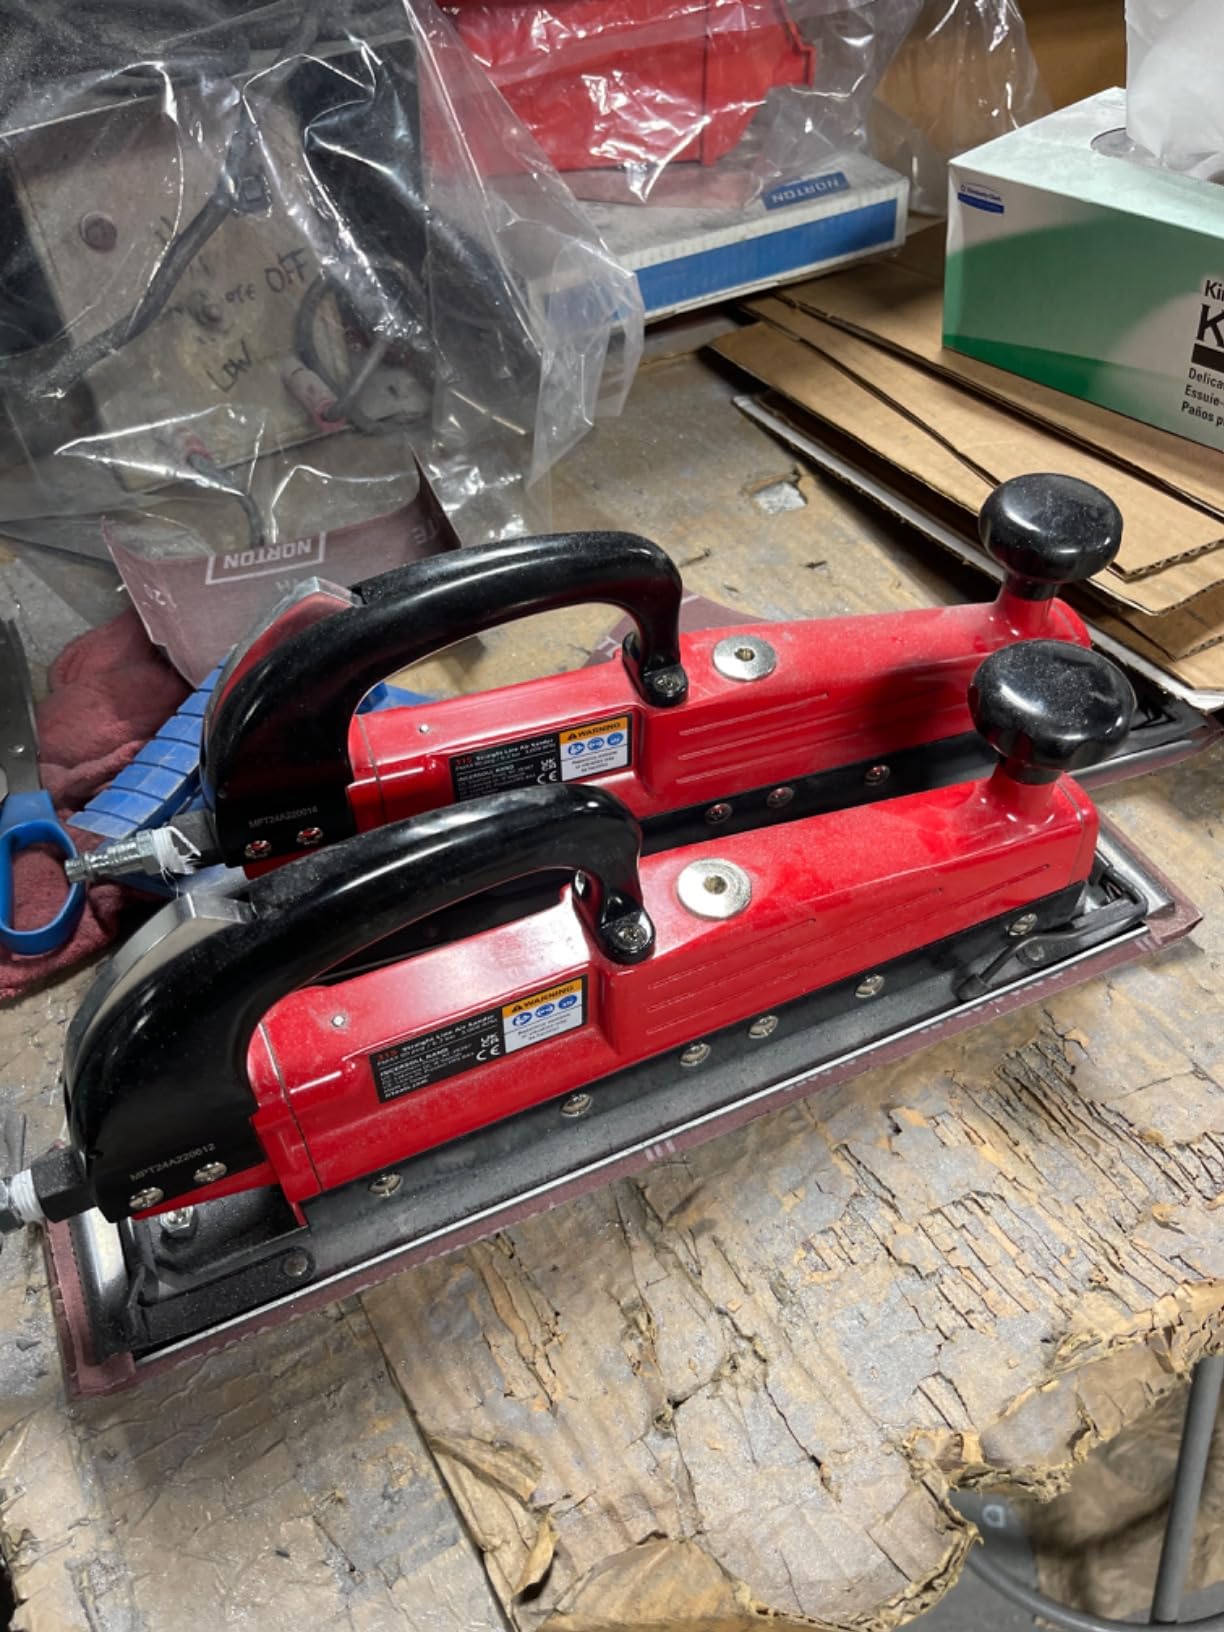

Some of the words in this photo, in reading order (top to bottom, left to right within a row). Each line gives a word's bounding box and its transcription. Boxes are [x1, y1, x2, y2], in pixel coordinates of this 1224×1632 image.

[771, 178, 840, 203] NORTON
[1181, 400, 1215, 422] Paños
[223, 538, 312, 570] NORTON
[578, 721, 621, 738] WARNING
[523, 984, 575, 1008] WARNING
